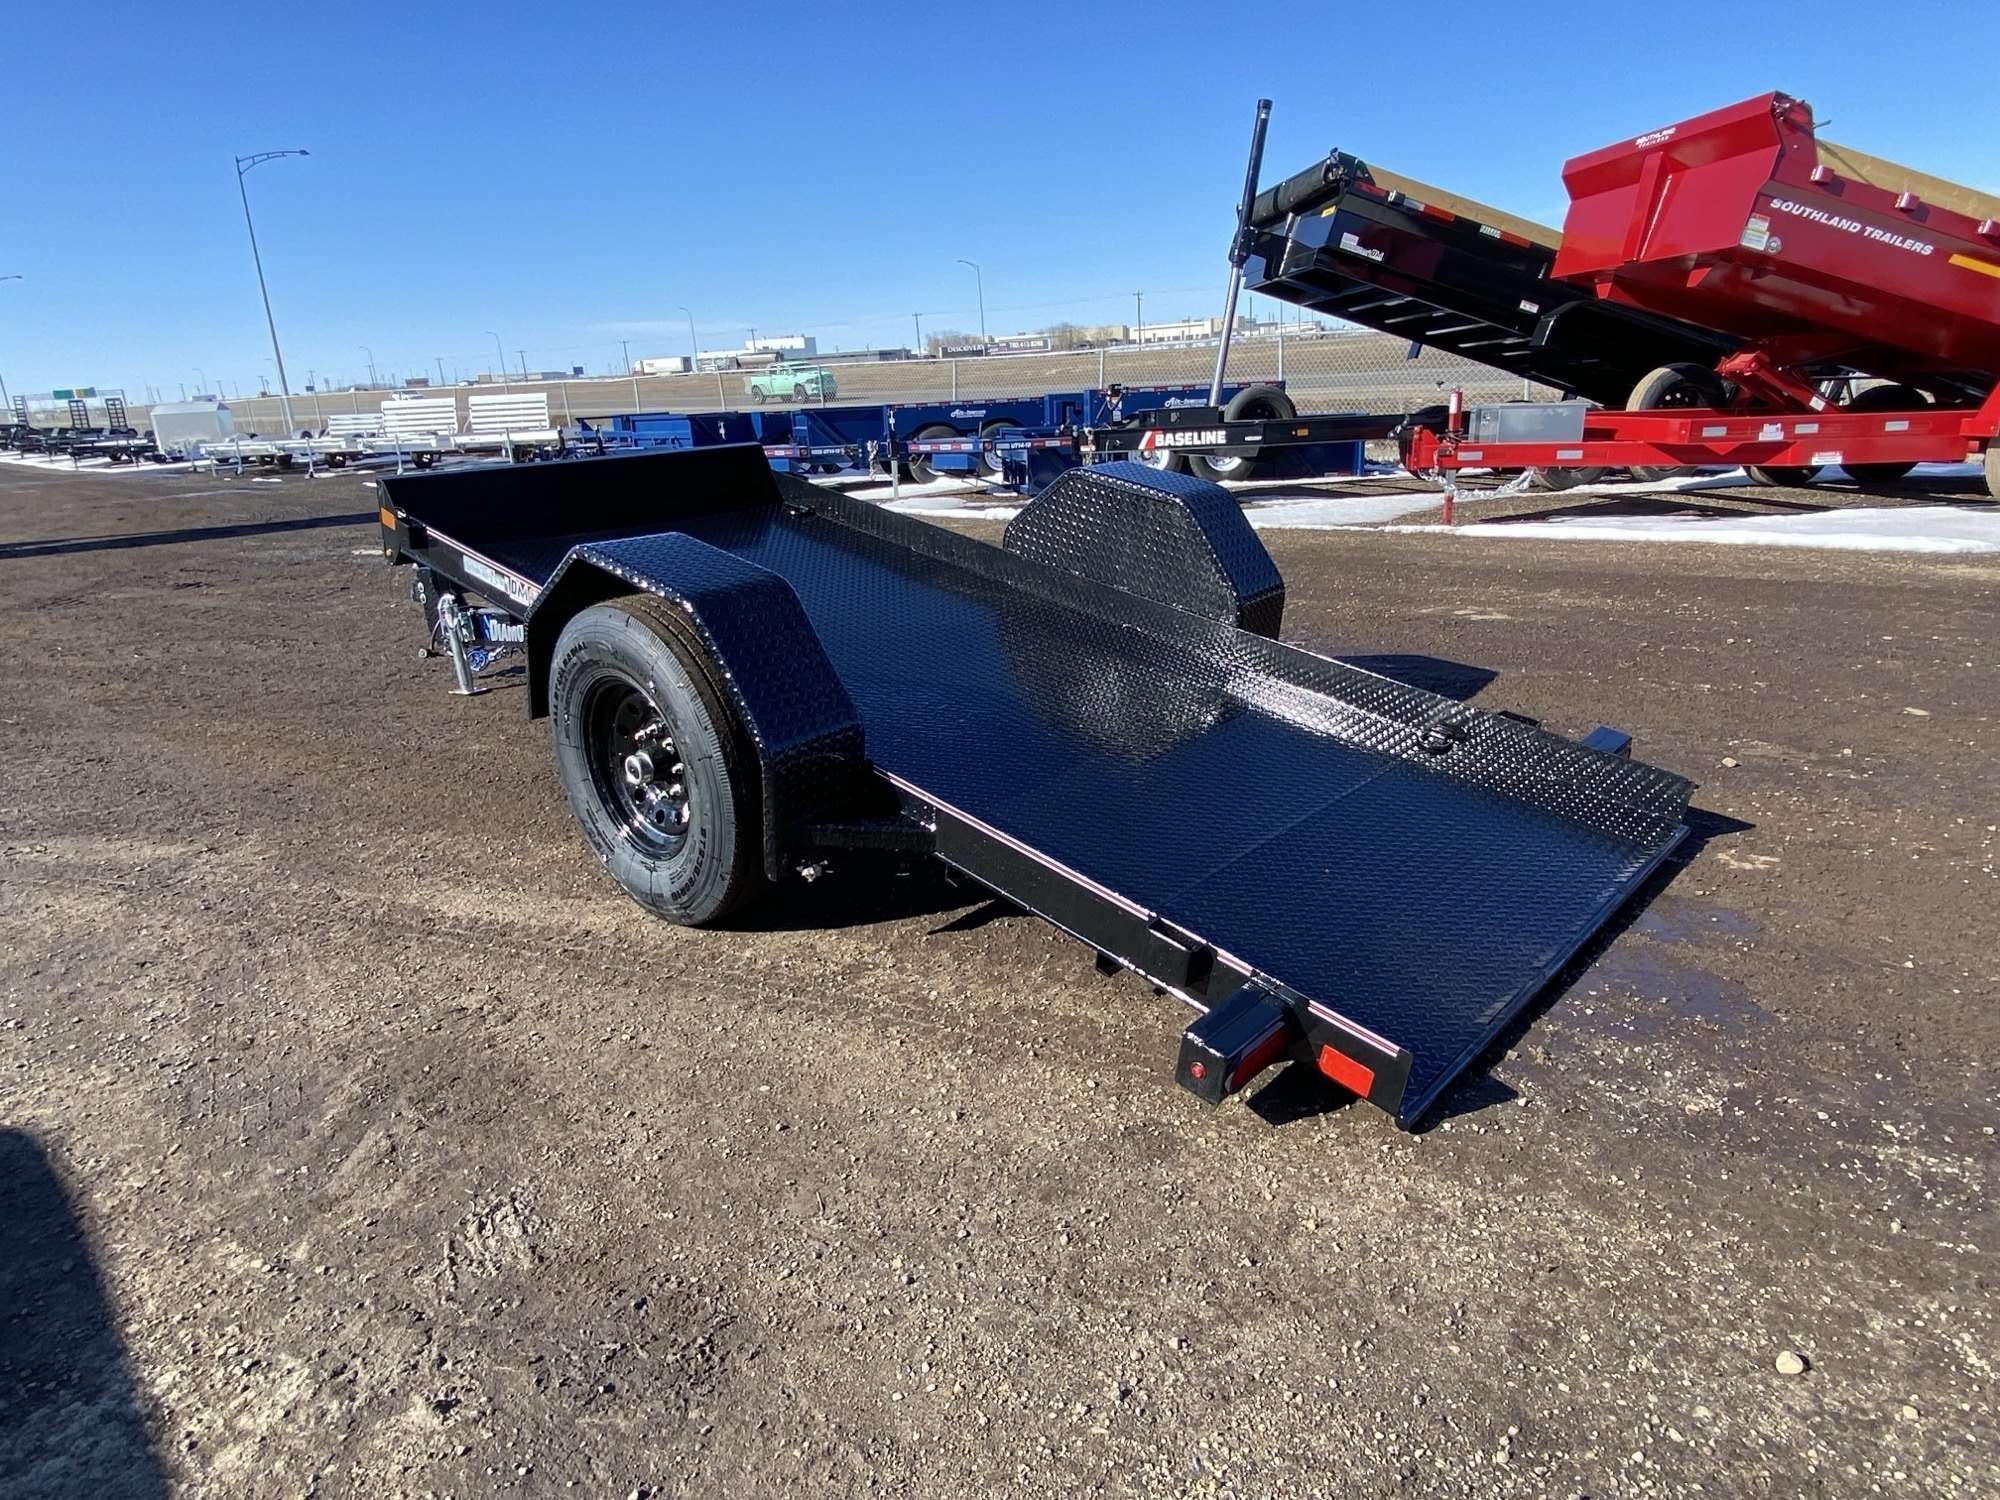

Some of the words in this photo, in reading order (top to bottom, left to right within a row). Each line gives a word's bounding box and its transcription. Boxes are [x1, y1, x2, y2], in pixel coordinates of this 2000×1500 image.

[1769, 198, 1862, 233] SOUTHLAND
[1863, 225, 1934, 256] TRAILERS
[1154, 430, 1226, 447] BASELINE
